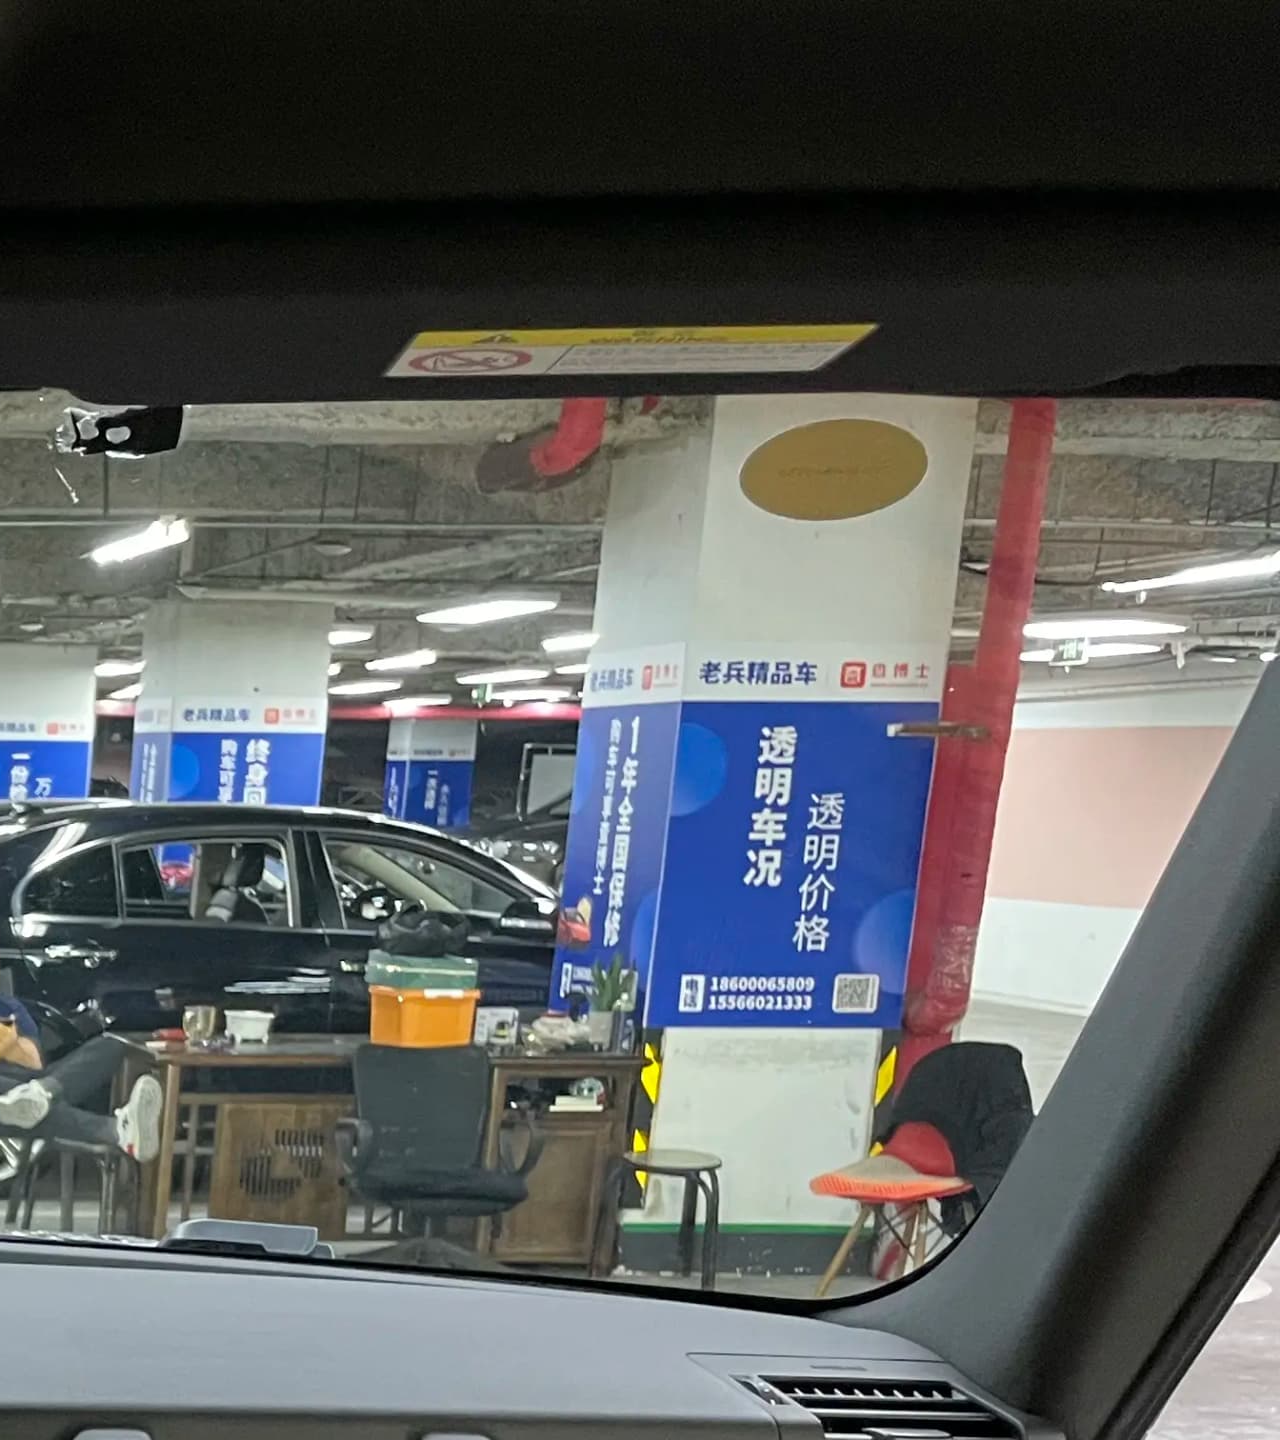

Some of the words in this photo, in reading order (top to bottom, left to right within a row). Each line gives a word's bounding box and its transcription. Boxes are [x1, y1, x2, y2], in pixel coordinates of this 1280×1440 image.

[699, 660, 818, 687] 老兵精品车
[744, 725, 798, 888] 透明车况
[793, 792, 845, 953] 透明价格
[711, 976, 815, 992] 18600065809
[708, 995, 813, 1011] 15566021333
